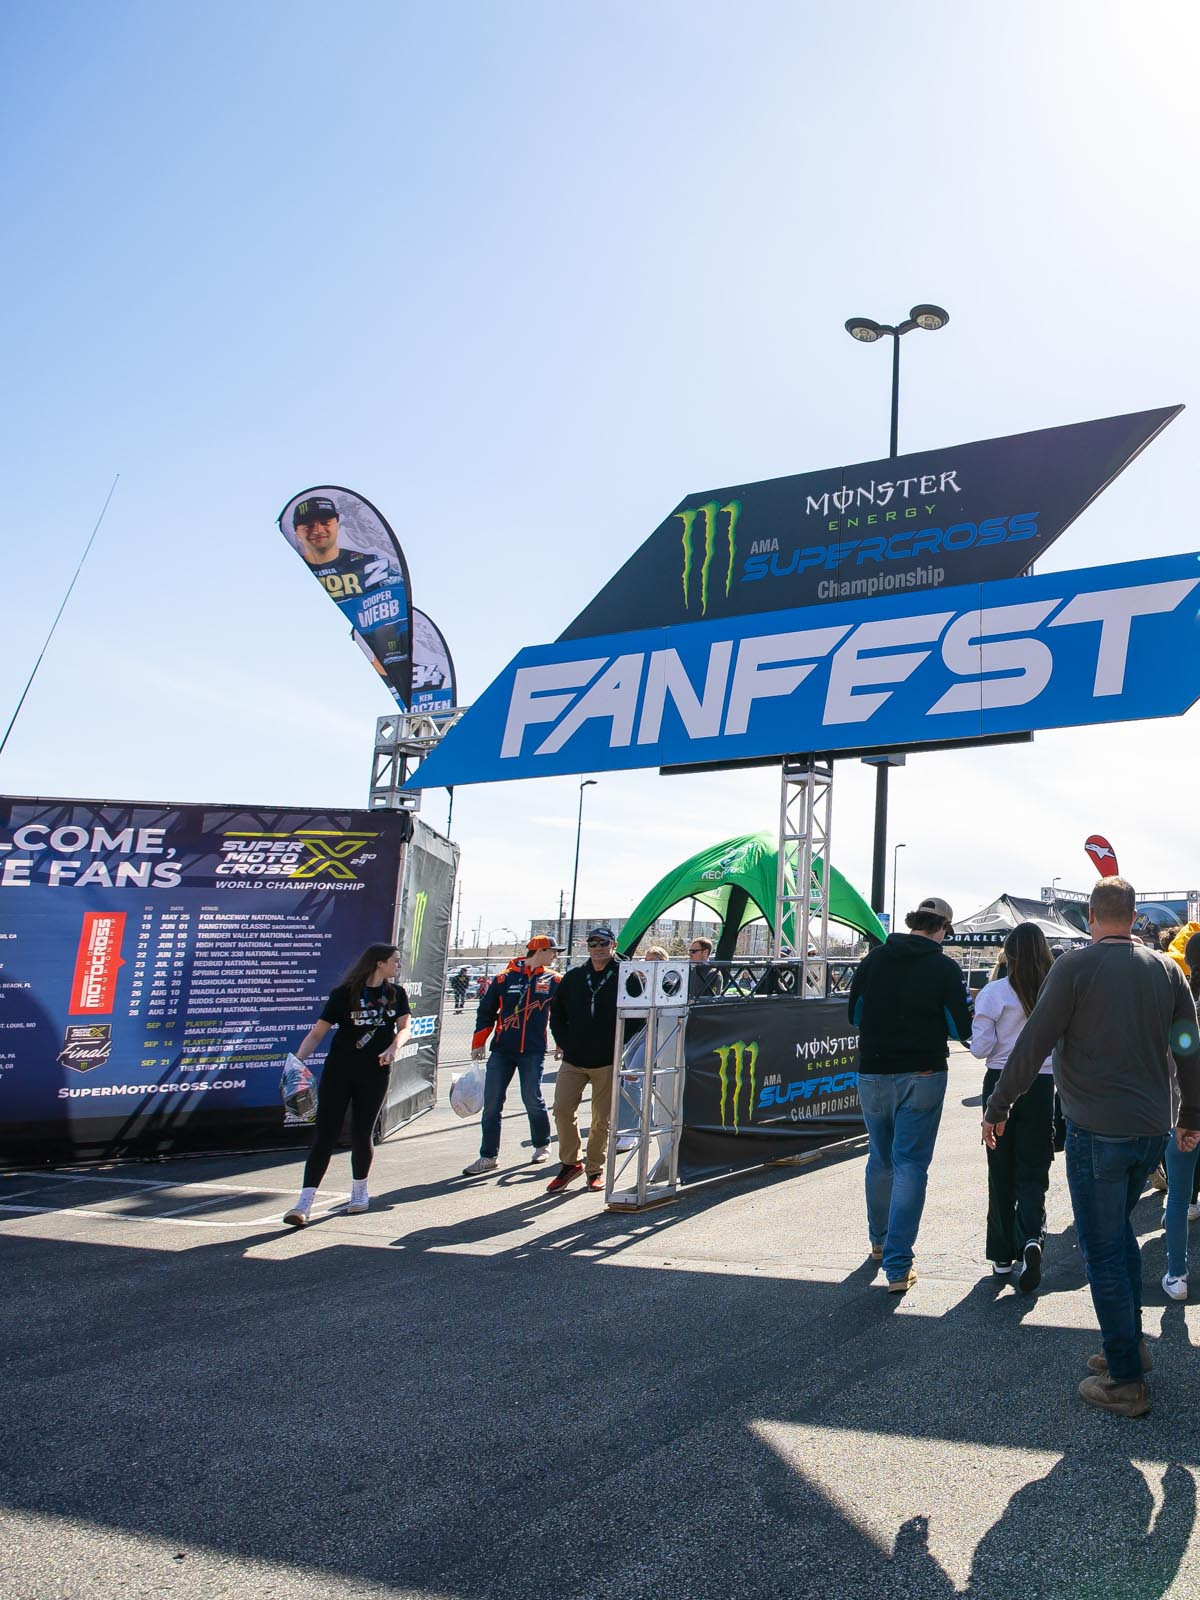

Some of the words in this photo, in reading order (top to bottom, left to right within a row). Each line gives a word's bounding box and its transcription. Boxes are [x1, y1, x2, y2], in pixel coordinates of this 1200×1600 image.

[805, 470, 962, 517] MONSTER
[828, 504, 937, 531] ENERGY
[740, 511, 1040, 582] SUPERCROSS
[750, 537, 780, 555] AMA
[364, 558, 390, 588] 2
[817, 565, 945, 600] Championship
[319, 573, 363, 598] OR
[362, 590, 393, 610] COOPER
[358, 599, 400, 628] WEBB
[410, 700, 451, 714] OCZEN
[419, 693, 433, 703] KEN
[0, 824, 177, 859] COME,
[220, 840, 305, 852] SUPER
[223, 852, 299, 863] MOTO
[0, 859, 34, 887] E
[48, 860, 183, 888] FANS
[215, 864, 299, 875] CROSS
[215, 881, 263, 889] WORLD
[266, 881, 366, 891] CHAMPIONSHIP
[954, 934, 1006, 942] OAKLEY
[85, 918, 112, 1008] MOTOCROSS
[255, 1024, 295, 1032] CHARLOTTE
[56, 1040, 113, 1062] Finals
[234, 1043, 273, 1051] SPEEDWAY
[245, 1061, 269, 1069] VEGAS
[807, 1056, 855, 1070] ENERGY
[763, 1073, 782, 1086] AMA
[757, 1071, 859, 1109] SUPERCR
[790, 1093, 860, 1122] CHAMPIONSHI
